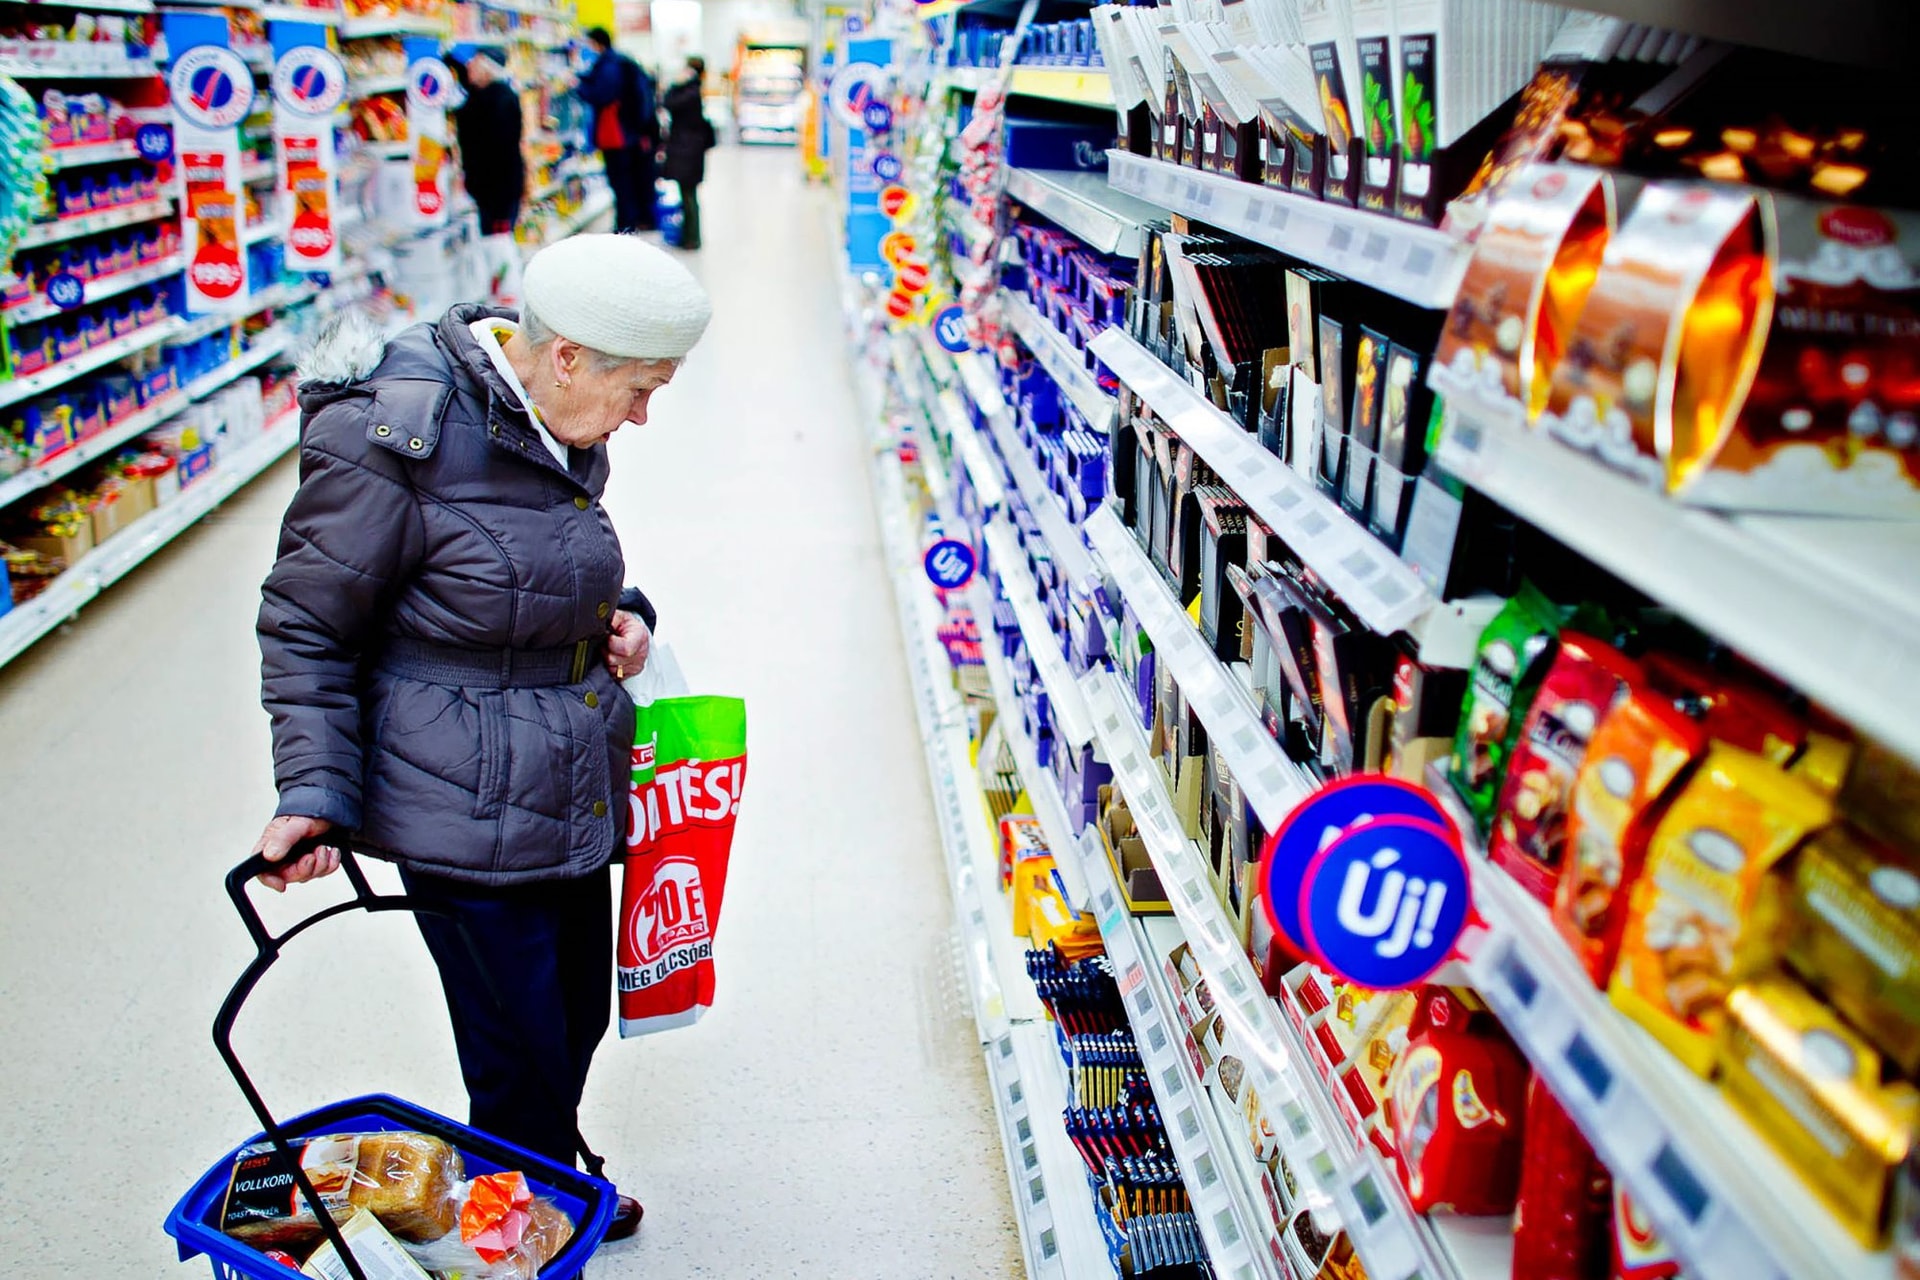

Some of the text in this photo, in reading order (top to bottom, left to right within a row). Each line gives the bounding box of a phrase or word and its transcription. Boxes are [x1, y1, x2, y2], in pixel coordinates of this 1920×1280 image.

[1337, 847, 1448, 959] Új!
[618, 966, 652, 991] MÉG
[235, 1173, 294, 1193] VOLLKORN
